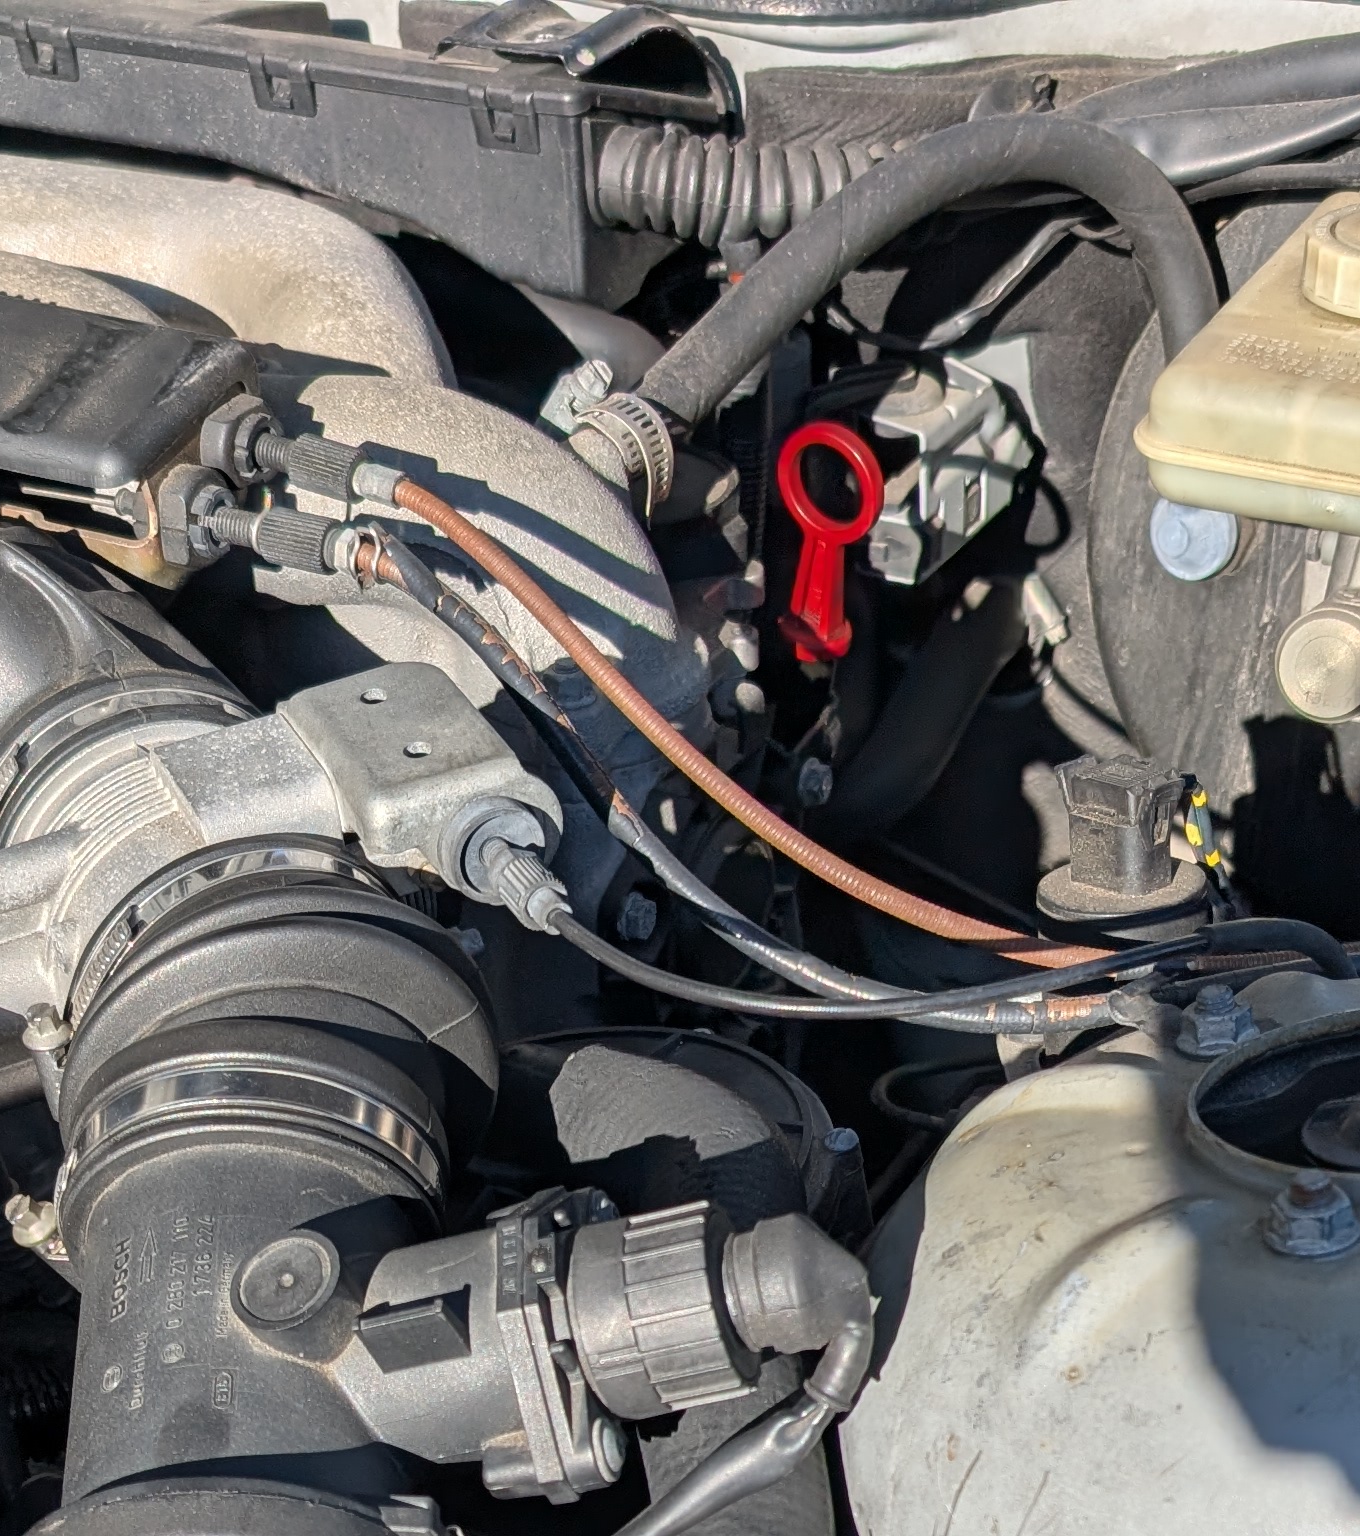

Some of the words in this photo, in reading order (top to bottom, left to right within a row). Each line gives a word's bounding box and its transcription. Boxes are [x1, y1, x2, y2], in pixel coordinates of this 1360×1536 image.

[196, 1213, 216, 1248] 224
[110, 1236, 132, 1323] BOSCH
[193, 1251, 214, 1285] 736
[165, 1317, 184, 1330] 0
